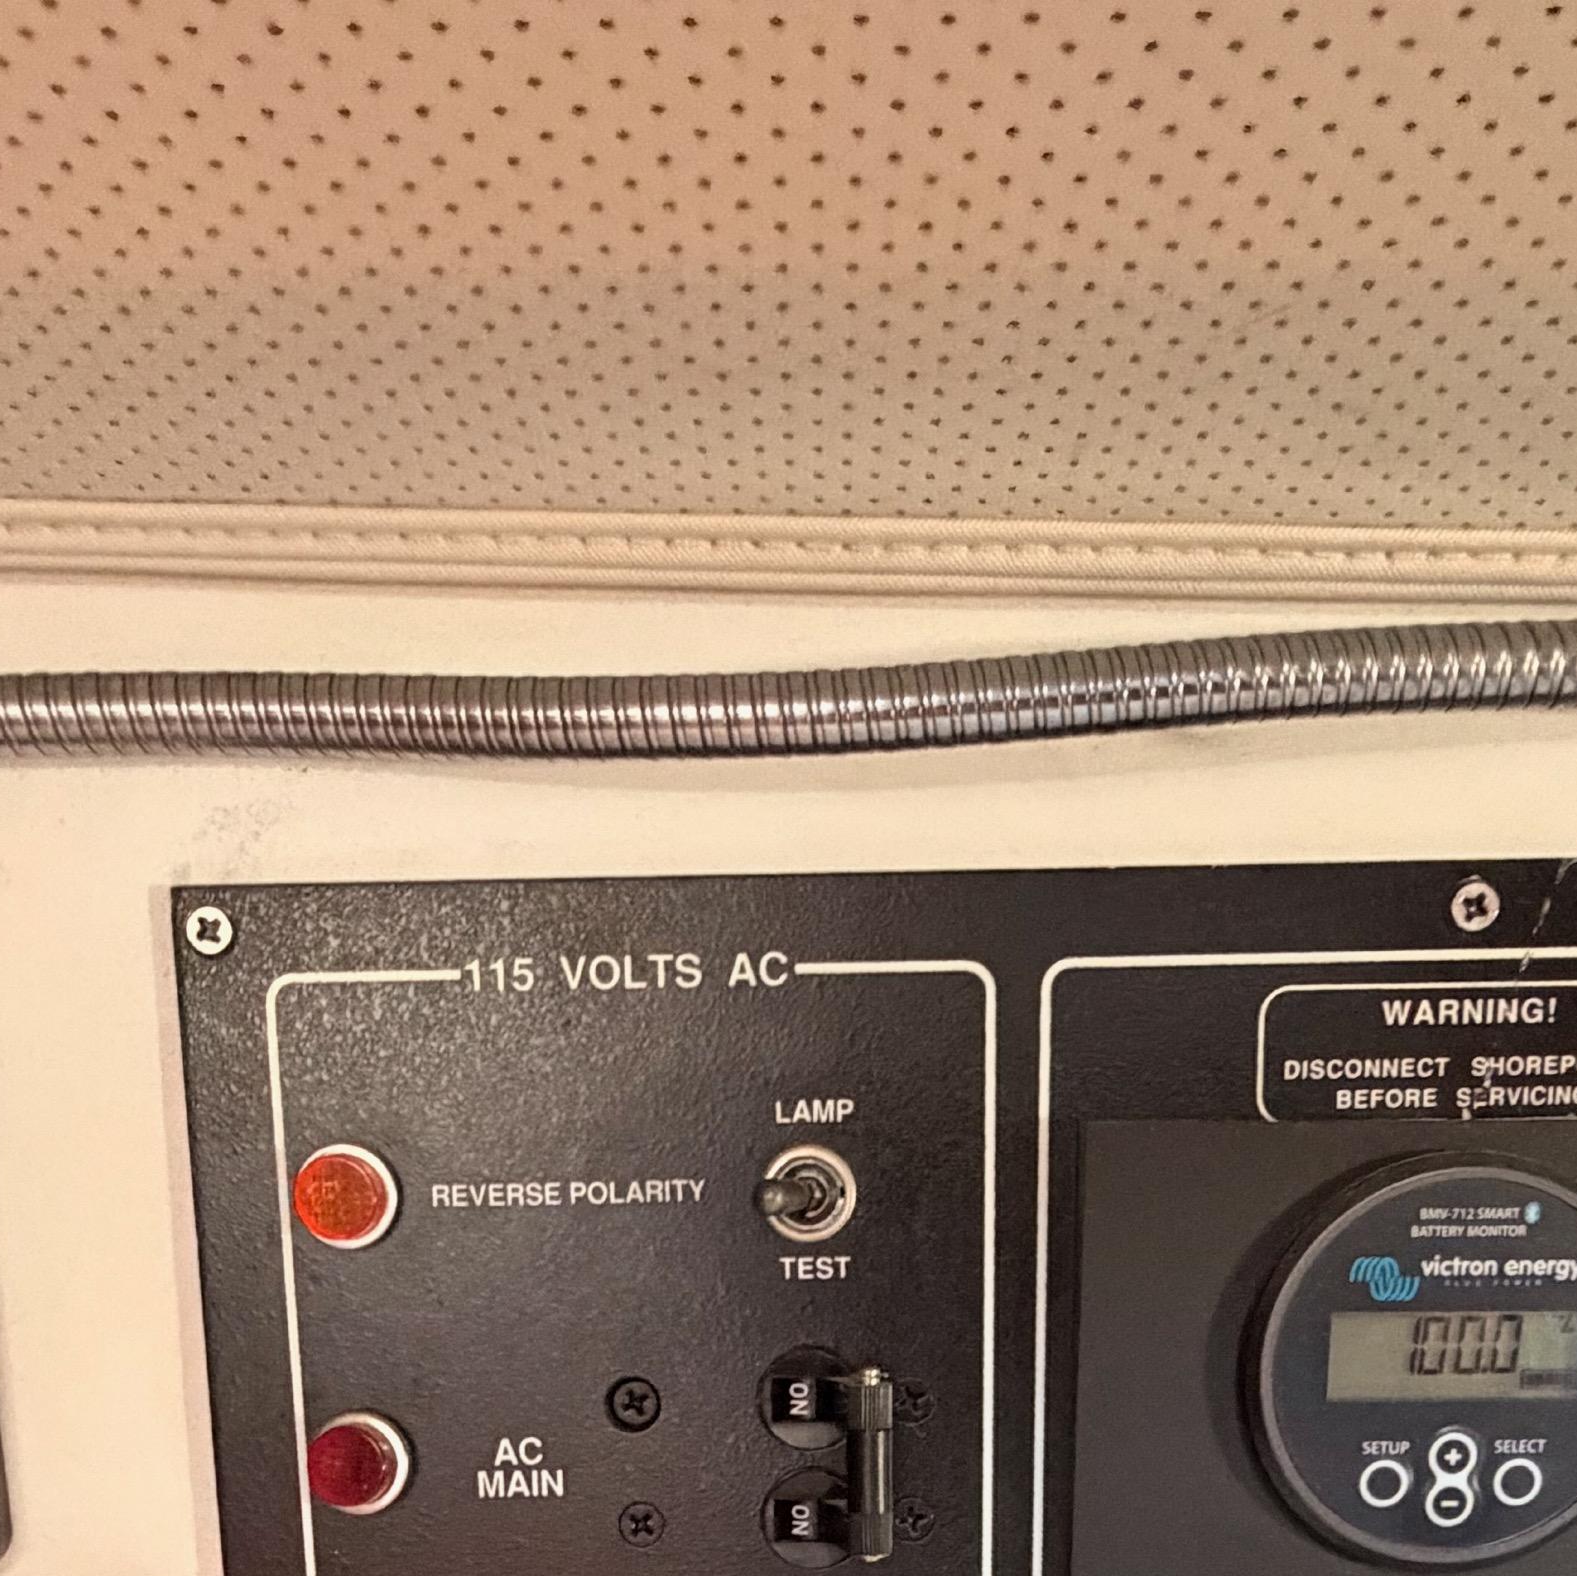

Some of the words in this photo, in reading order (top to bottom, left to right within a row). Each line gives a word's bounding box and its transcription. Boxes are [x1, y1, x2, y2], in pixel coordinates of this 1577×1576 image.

[465, 958, 535, 992] 115
[560, 953, 703, 991] VOLTS
[729, 951, 789, 987] AC
[1382, 997, 1557, 1026] WARNING!
[1284, 1056, 1450, 1080] DISCONNECT
[775, 1099, 854, 1124] LAMP
[1336, 1088, 1437, 1110] BEFORE
[432, 1182, 562, 1208] REVERSE
[571, 1179, 705, 1206] POLARITY
[1476, 1206, 1521, 1220] SMART
[1411, 1224, 1465, 1238] BATTERY
[1467, 1224, 1528, 1238] MONITOR
[779, 1255, 851, 1280] TEST
[1421, 1253, 1498, 1277] victron
[1409, 1313, 1523, 1375] 100.0
[494, 1436, 543, 1467] AC
[1361, 1440, 1410, 1456] SETUP
[1494, 1439, 1547, 1455] SELECT
[477, 1469, 564, 1499] MAIN
